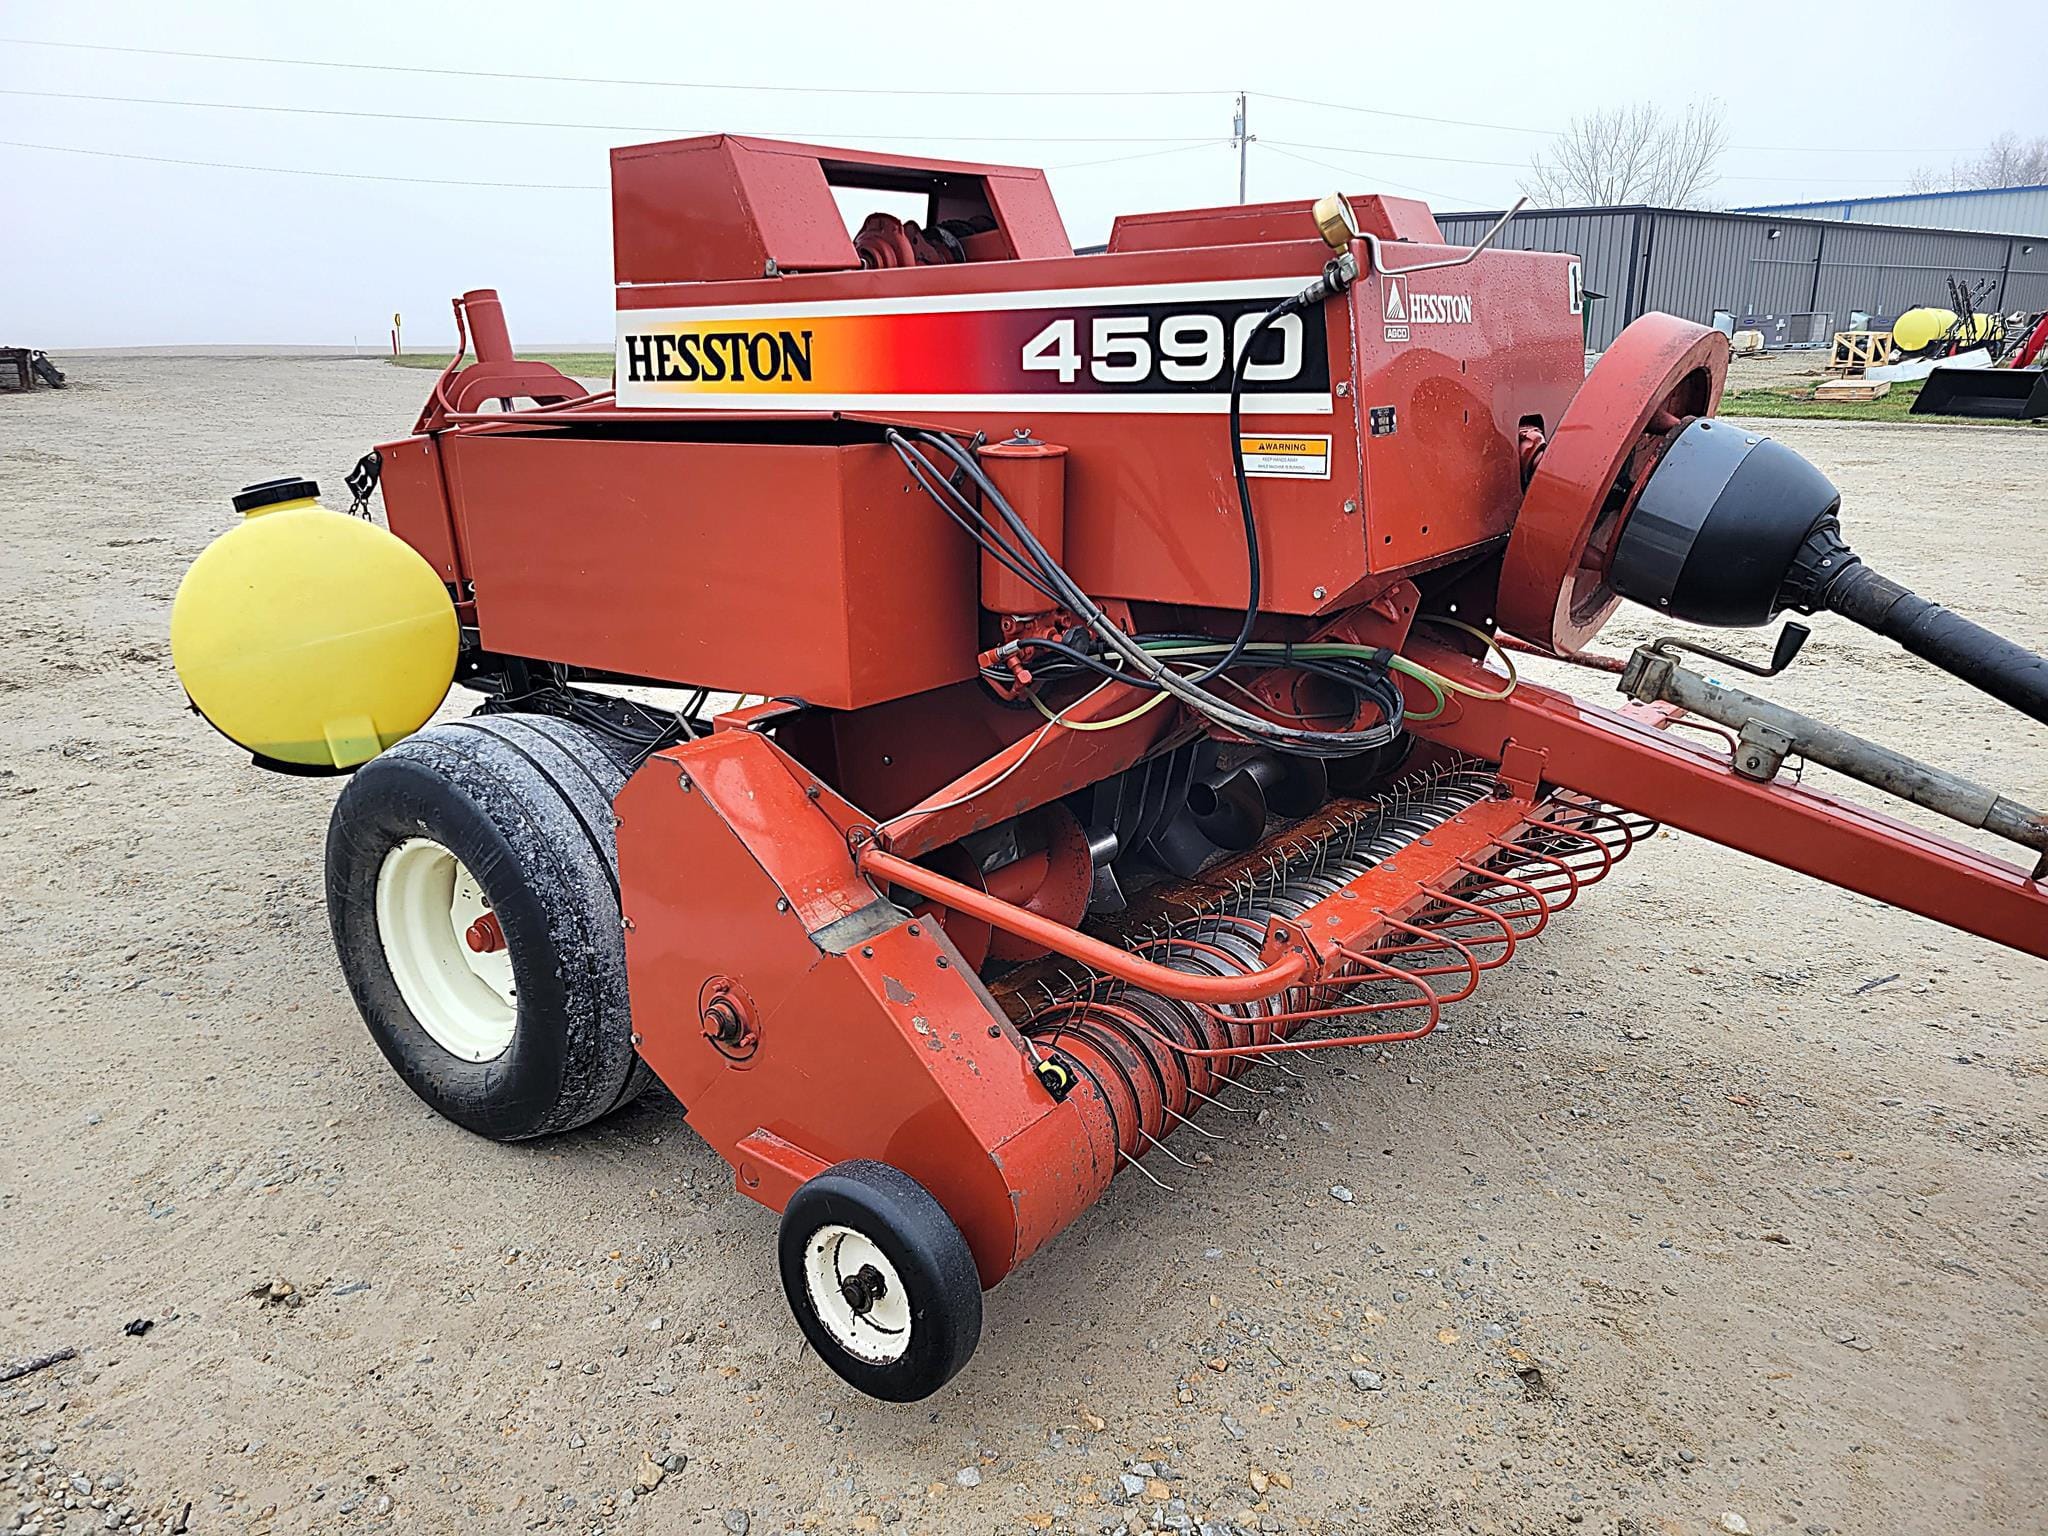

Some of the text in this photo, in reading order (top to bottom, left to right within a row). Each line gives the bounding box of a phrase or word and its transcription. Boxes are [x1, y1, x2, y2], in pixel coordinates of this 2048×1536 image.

[1409, 294, 1472, 323] HESSTON
[1387, 328, 1407, 338] AGCO
[625, 312, 1303, 383] HESSTON 4590
[1266, 443, 1306, 451] WARNING
